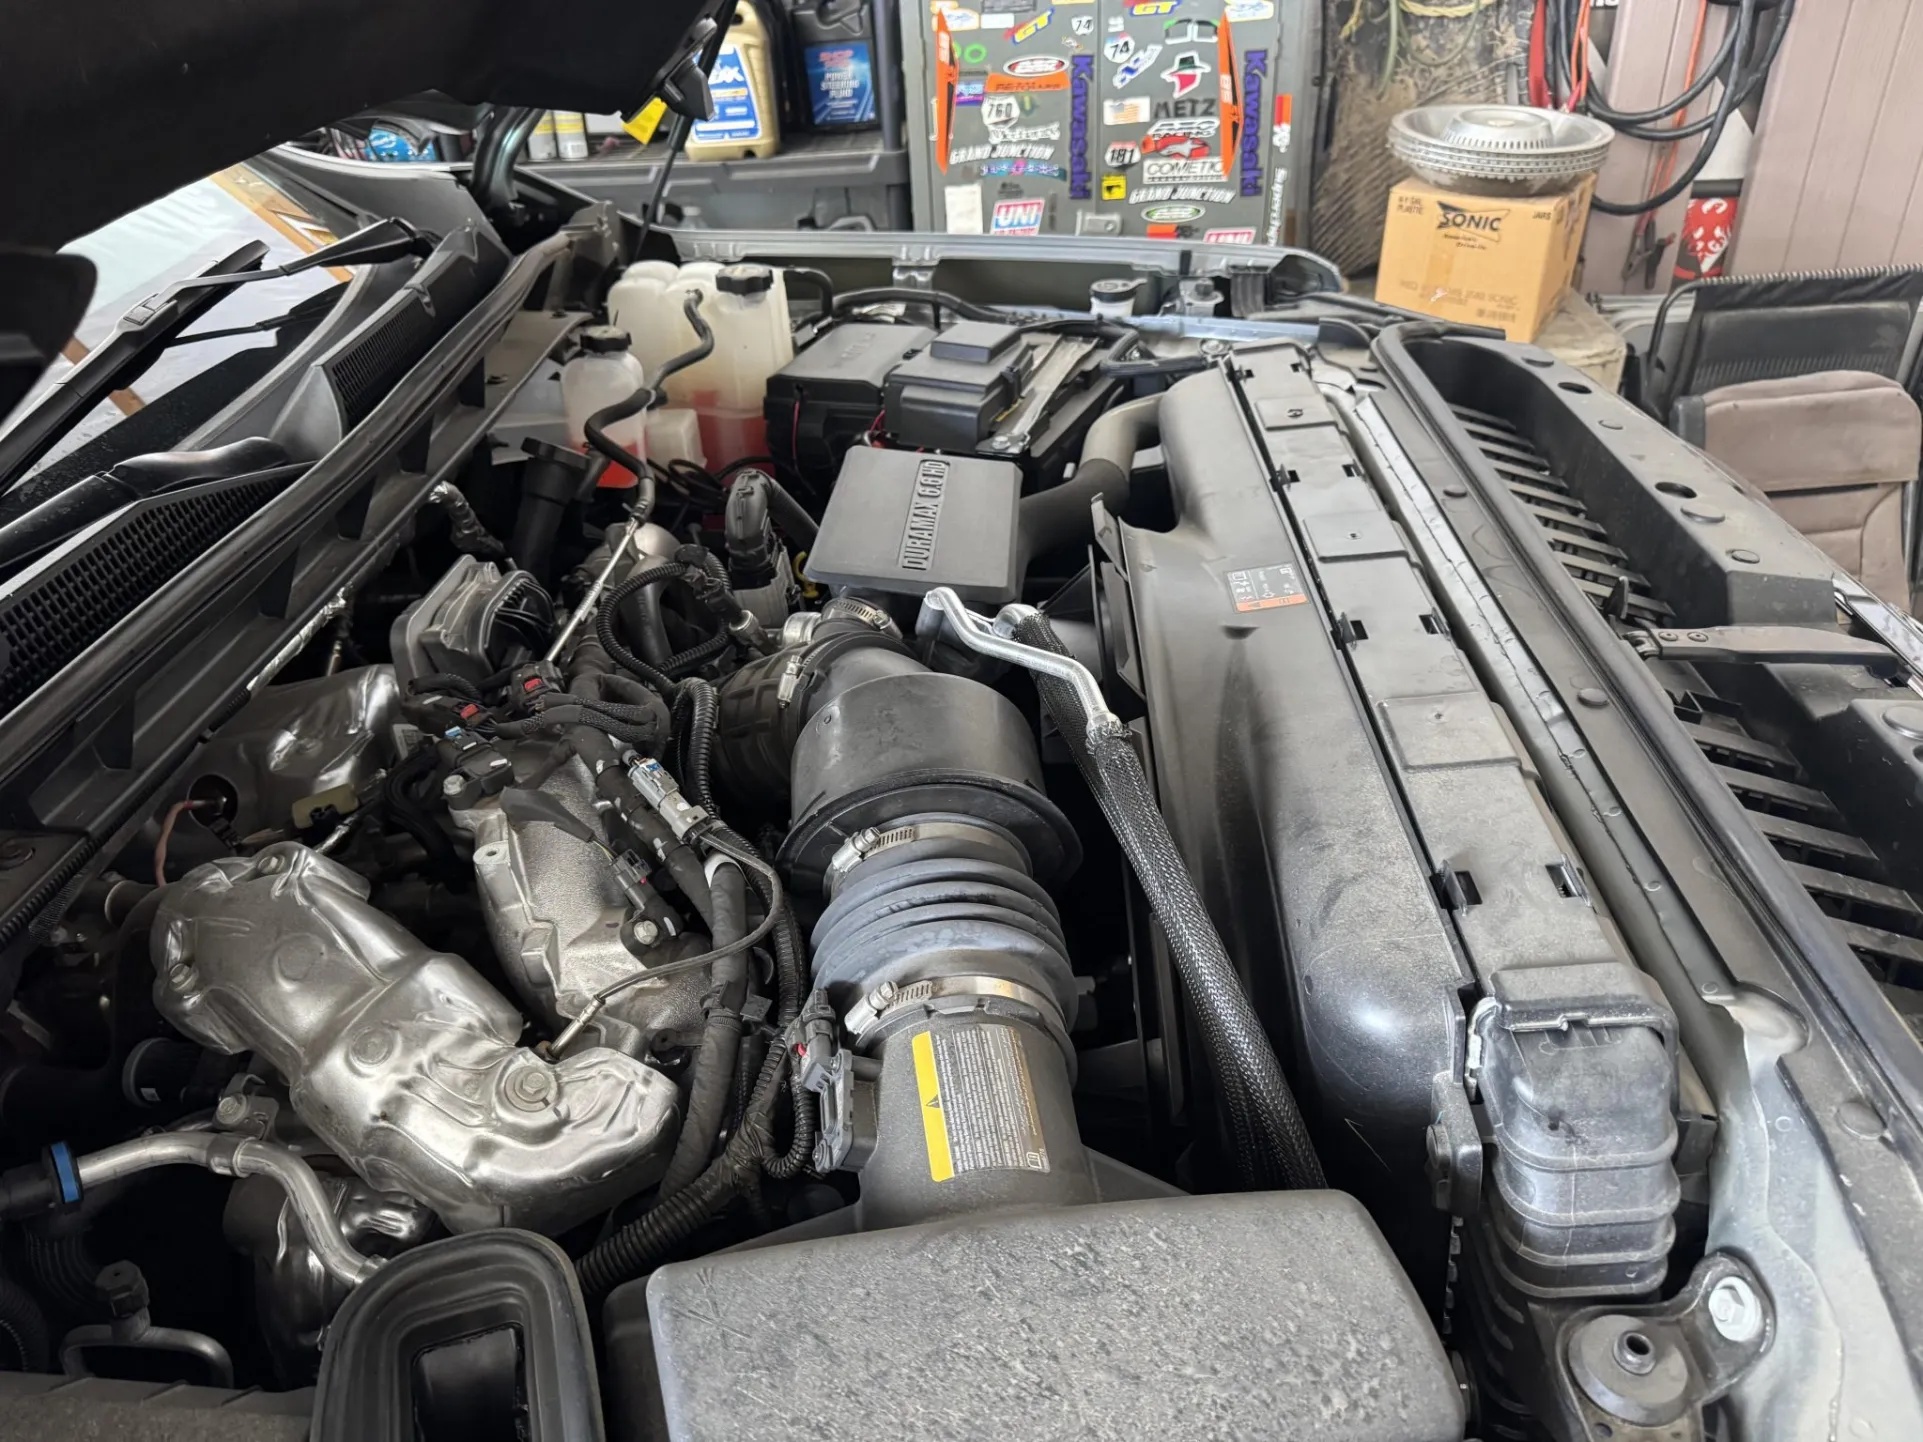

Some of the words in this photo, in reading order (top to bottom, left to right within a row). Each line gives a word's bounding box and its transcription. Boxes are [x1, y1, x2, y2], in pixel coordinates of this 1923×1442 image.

[1075, 19, 1092, 32] 74
[1109, 40, 1130, 59] 74
[1153, 98, 1216, 118] METZ
[1070, 54, 1094, 200] Kawasaki
[1240, 50, 1268, 196] Kawasaki
[949, 144, 993, 164] GRAND
[991, 143, 1055, 160] JUNCTION
[1128, 187, 1173, 204] GRAND
[1171, 185, 1237, 203] JUNCTION
[997, 203, 1040, 227] UNI
[1440, 210, 1502, 232] SONIC
[902, 502, 941, 571] DURAMAX
